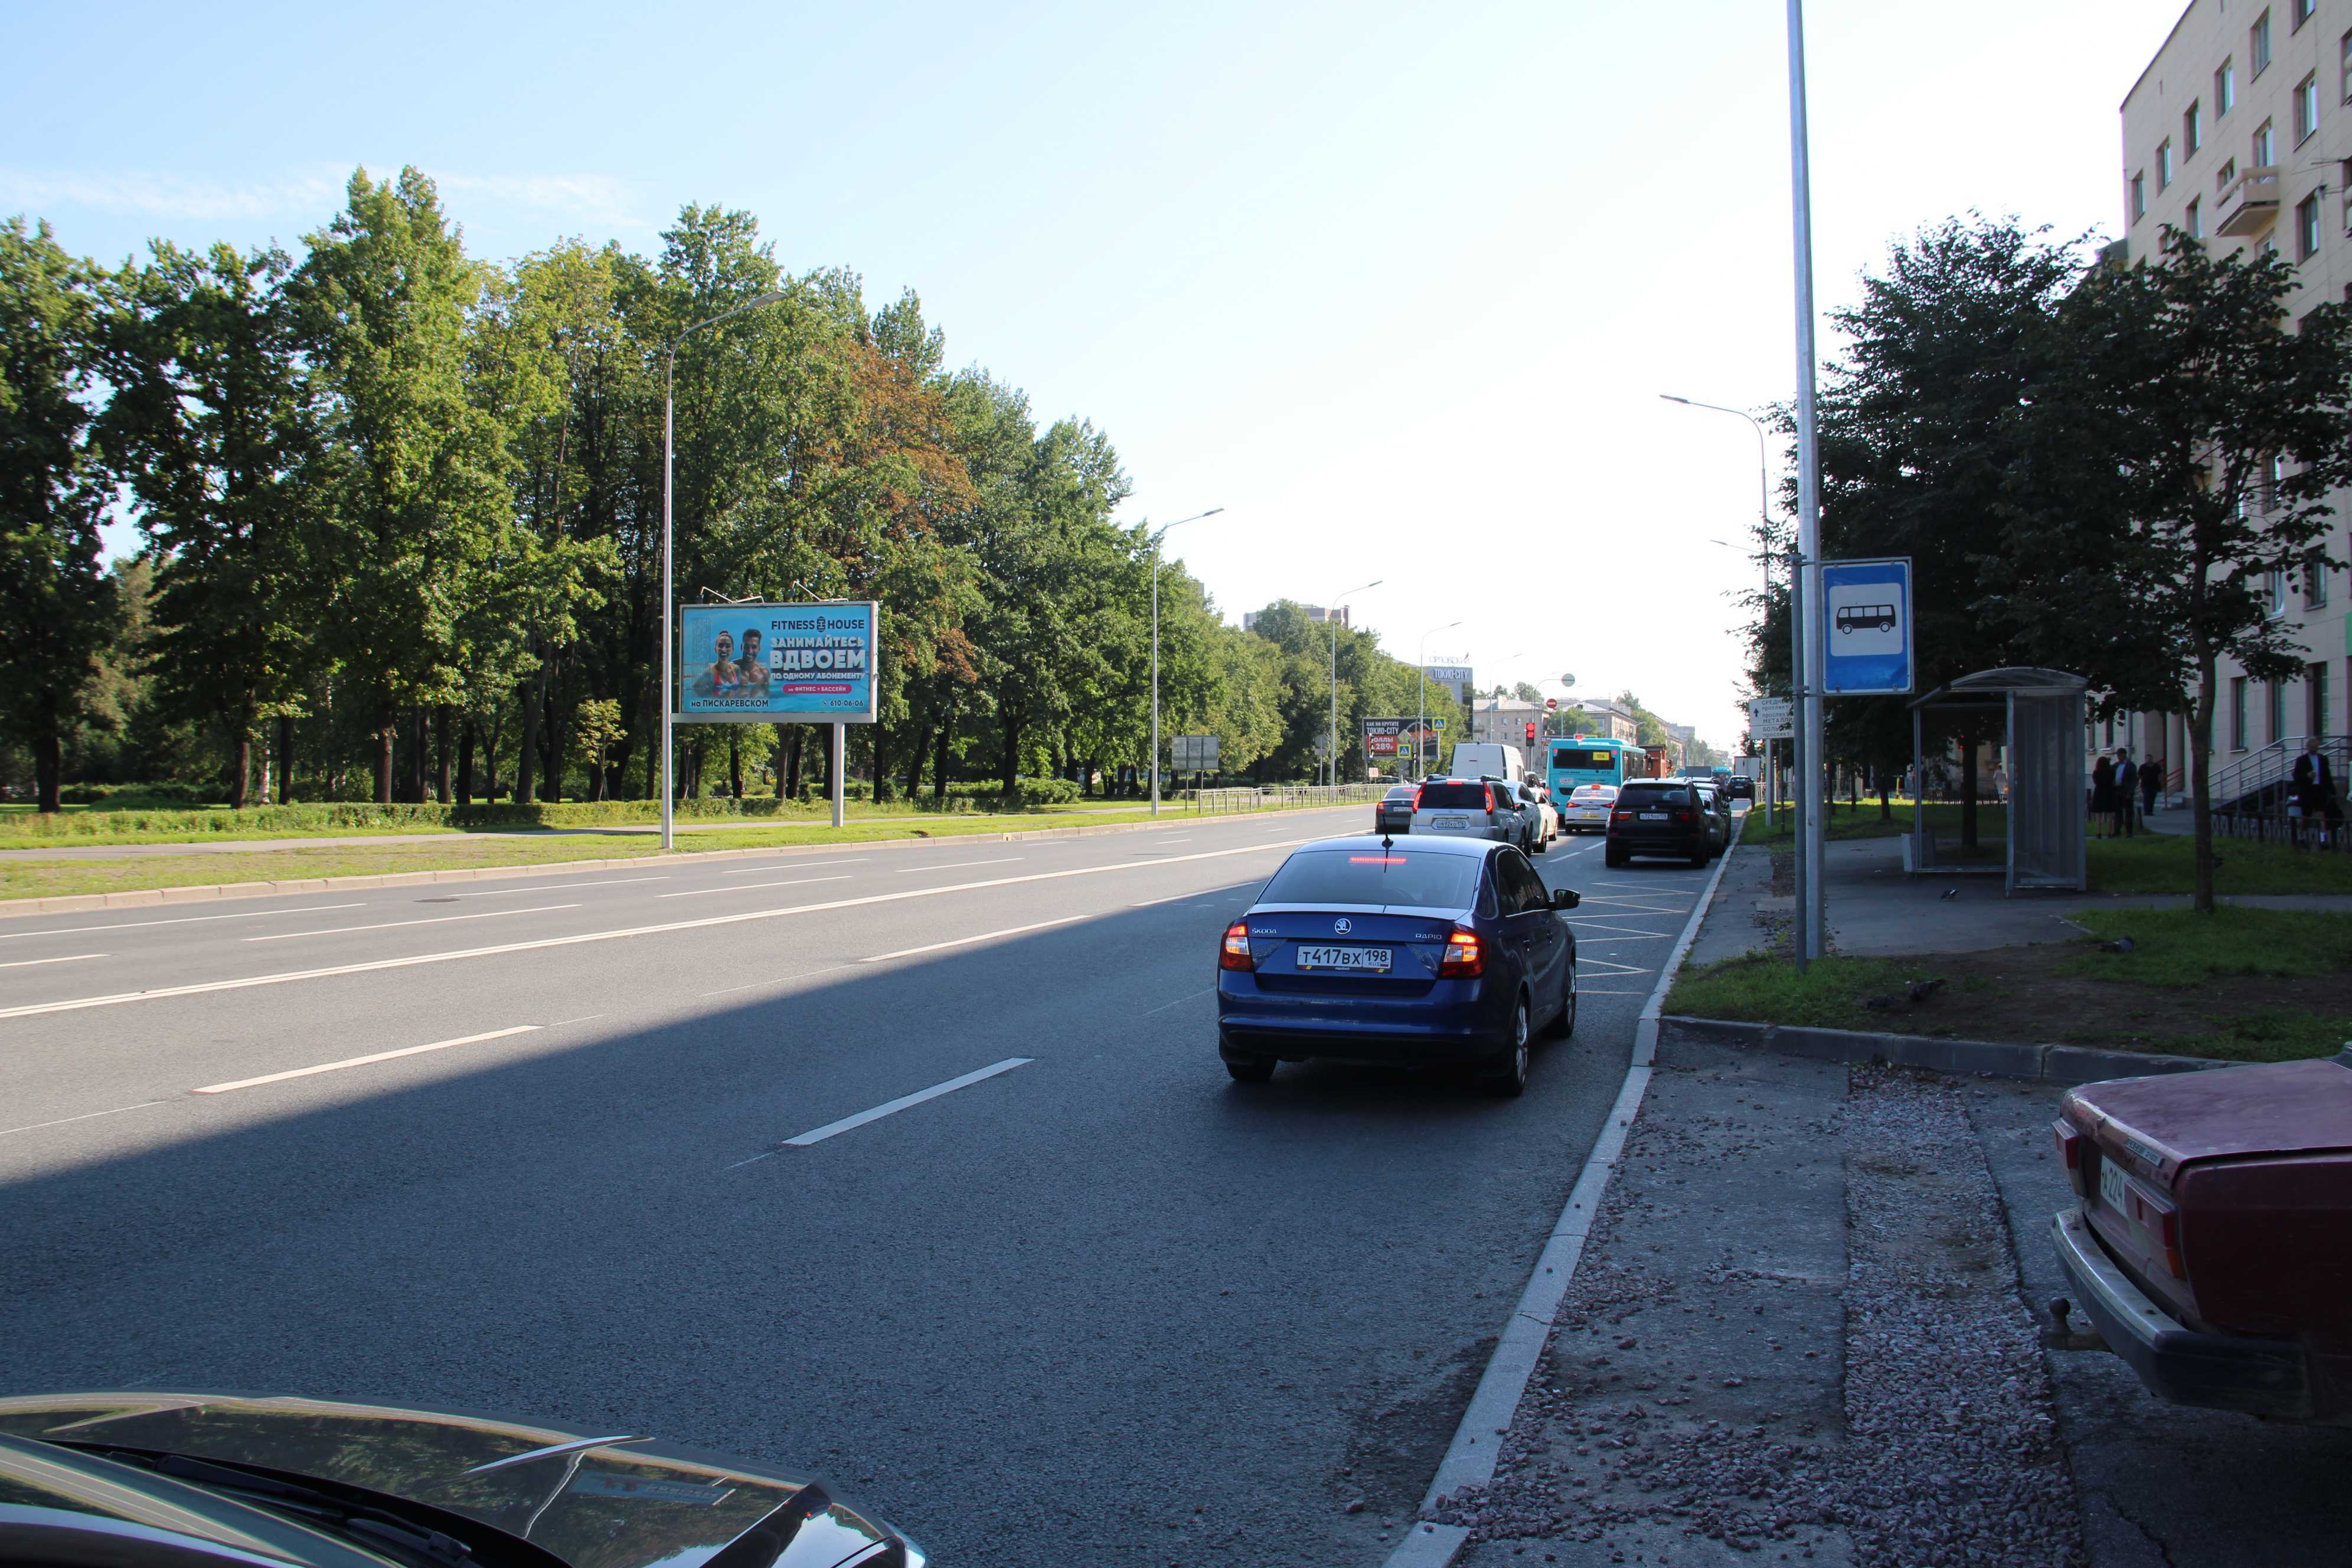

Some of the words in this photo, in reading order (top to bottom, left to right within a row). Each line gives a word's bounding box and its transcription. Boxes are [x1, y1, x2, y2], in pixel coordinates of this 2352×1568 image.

[772, 620, 815, 630] FITNESS
[827, 619, 865, 629] HOUSE
[770, 635, 865, 648] ЗАНИМАЙТЕСЬ
[770, 649, 865, 671] ВДВОЕМ
[783, 672, 816, 680] ОДНОМУ
[1364, 949, 1387, 962] 198
